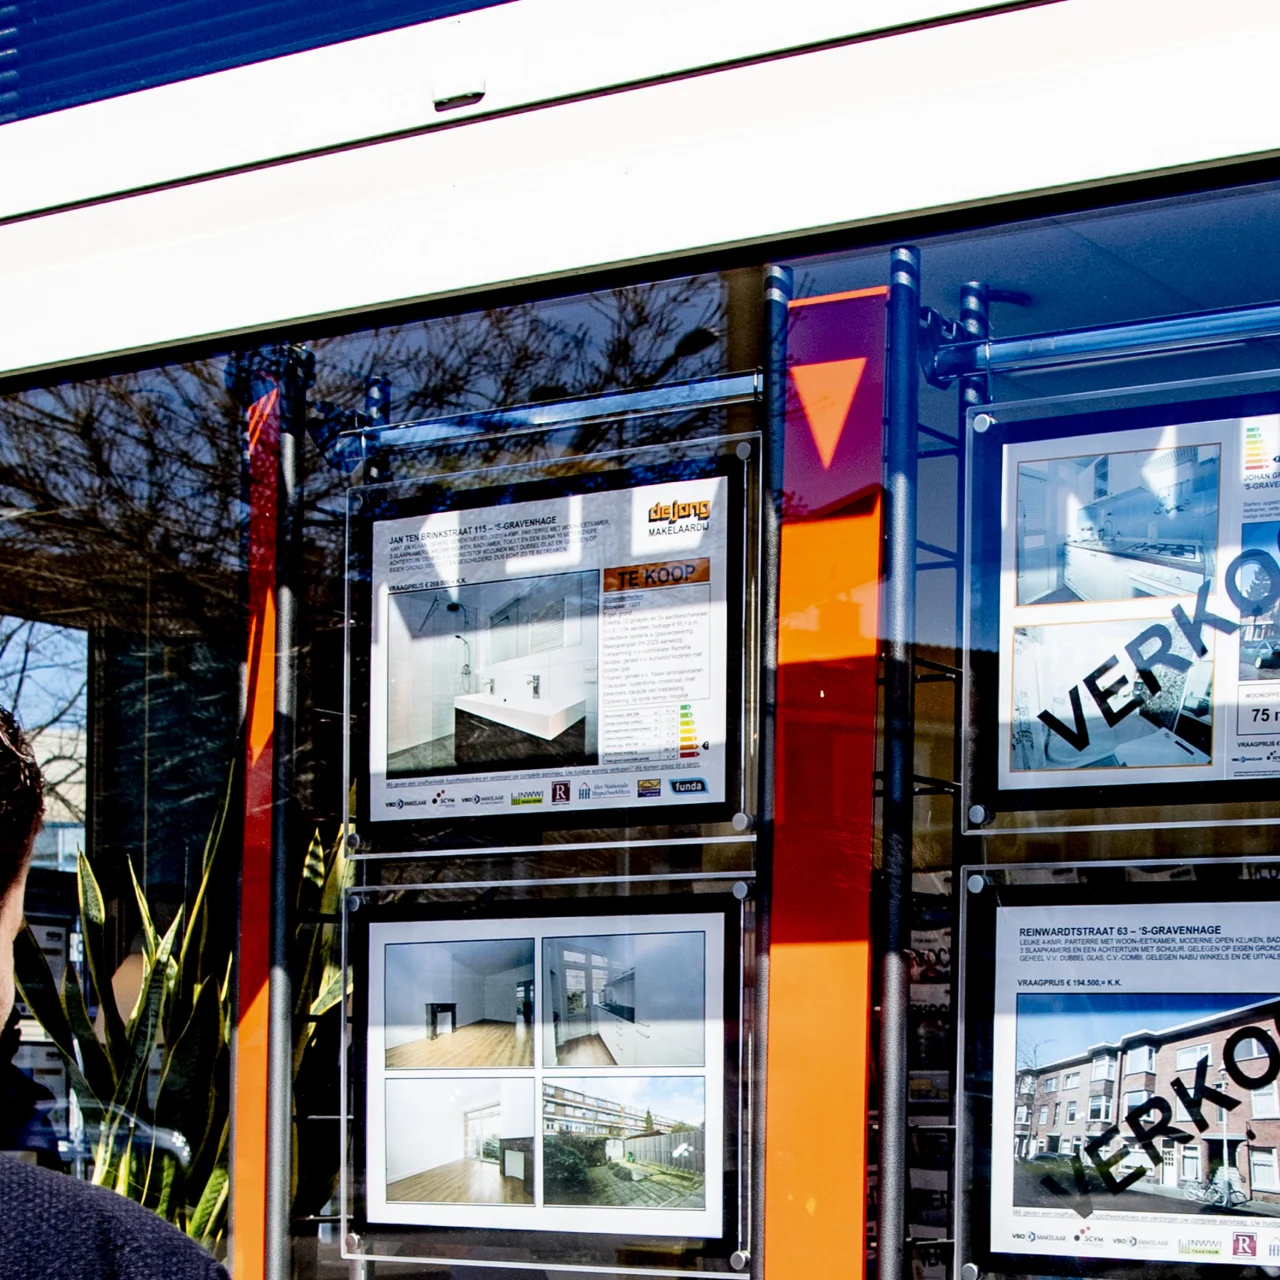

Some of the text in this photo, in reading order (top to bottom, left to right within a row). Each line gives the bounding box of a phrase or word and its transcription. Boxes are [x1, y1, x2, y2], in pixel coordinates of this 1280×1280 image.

[1244, 473, 1270, 481] JOHAN
[389, 516, 557, 544] JAN TEN BRINKSTRAAT 115 'S-GRAVENHAGE
[648, 522, 709, 537] MAKELAARDIJ
[618, 565, 695, 588] TE KOOP
[1252, 709, 1270, 722] 75
[1237, 740, 1275, 748] VRAAGPRIJS
[674, 781, 702, 792] funda
[1019, 925, 1221, 937] REINWARDTSTRAAT 63 'S-GRAVENHAGE
[1018, 979, 1064, 987] VRAAGPRIJS
[1073, 978, 1105, 987] 194.500,=
